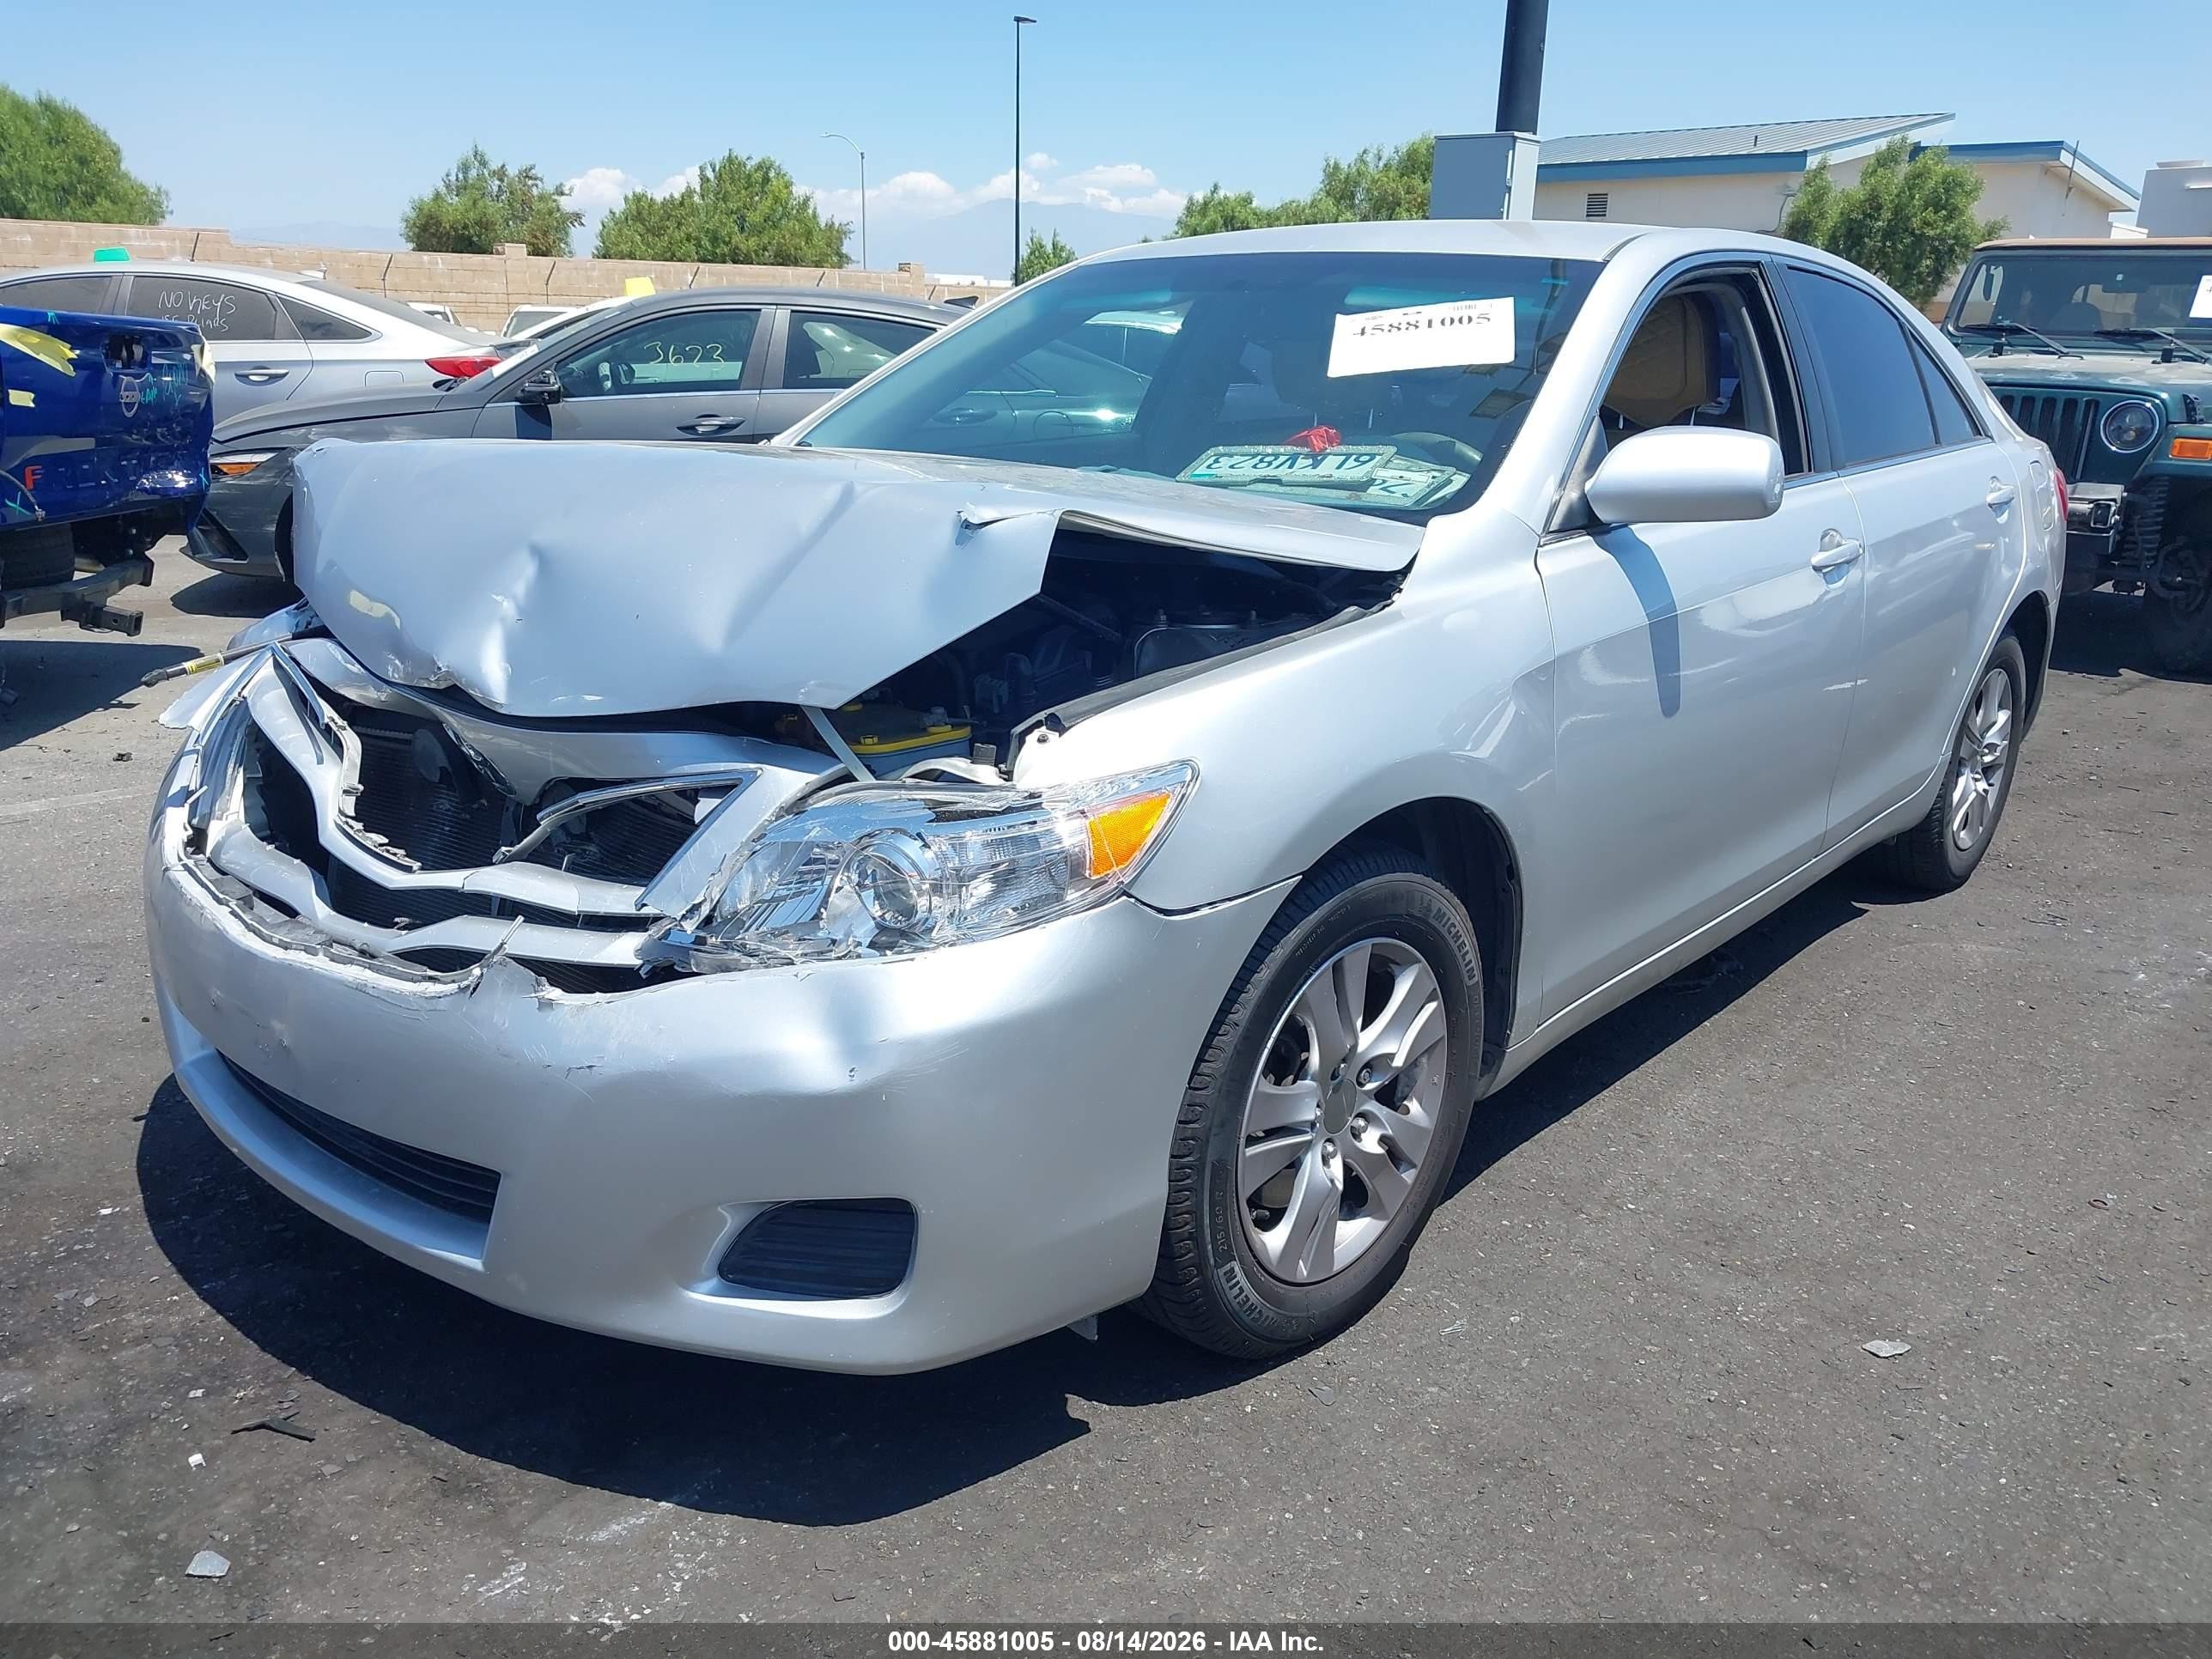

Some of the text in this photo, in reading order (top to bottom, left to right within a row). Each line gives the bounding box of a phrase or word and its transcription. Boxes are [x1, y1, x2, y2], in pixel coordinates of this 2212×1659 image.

[158, 290, 184, 309] NO
[1352, 313, 1491, 337] 45881005
[1206, 453, 1370, 471] 6LKV823
[1432, 907, 1476, 981] MICHELIN
[1223, 1266, 1279, 1327] MICHELIN
